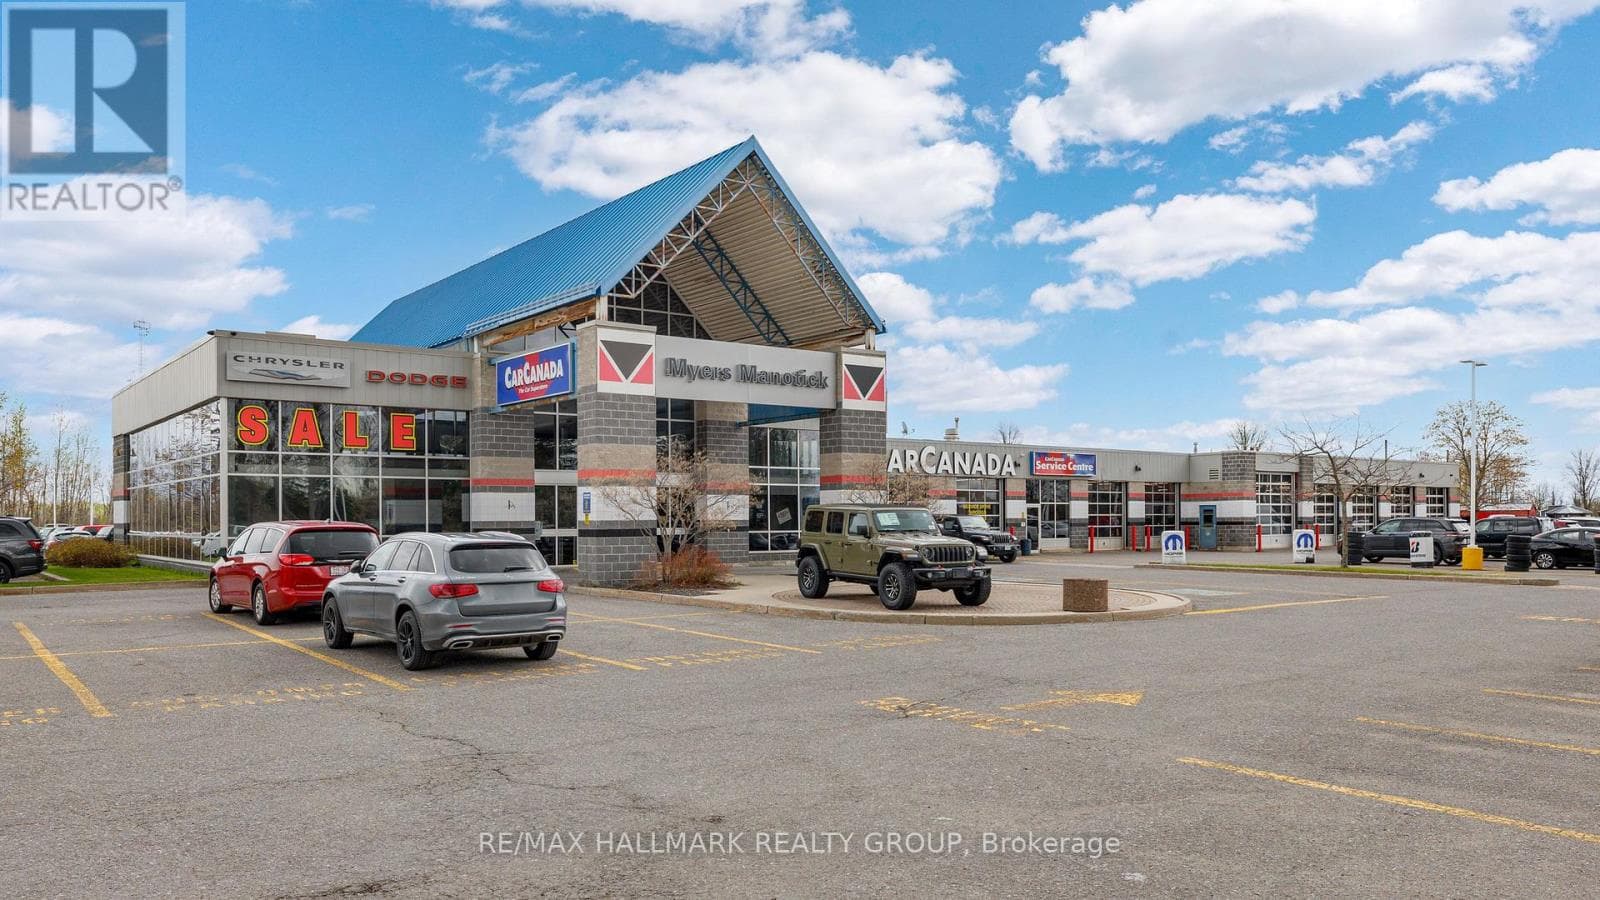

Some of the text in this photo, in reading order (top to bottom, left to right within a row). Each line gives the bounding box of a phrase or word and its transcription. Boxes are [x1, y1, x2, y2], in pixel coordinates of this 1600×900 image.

[233, 354, 345, 370] CHRYSLER
[664, 357, 829, 389] Myers Manotick
[366, 369, 468, 388] DODGE
[237, 405, 417, 450] SALE
[887, 446, 1017, 476] ARCANADA
[1035, 461, 1094, 471] Service Centre
